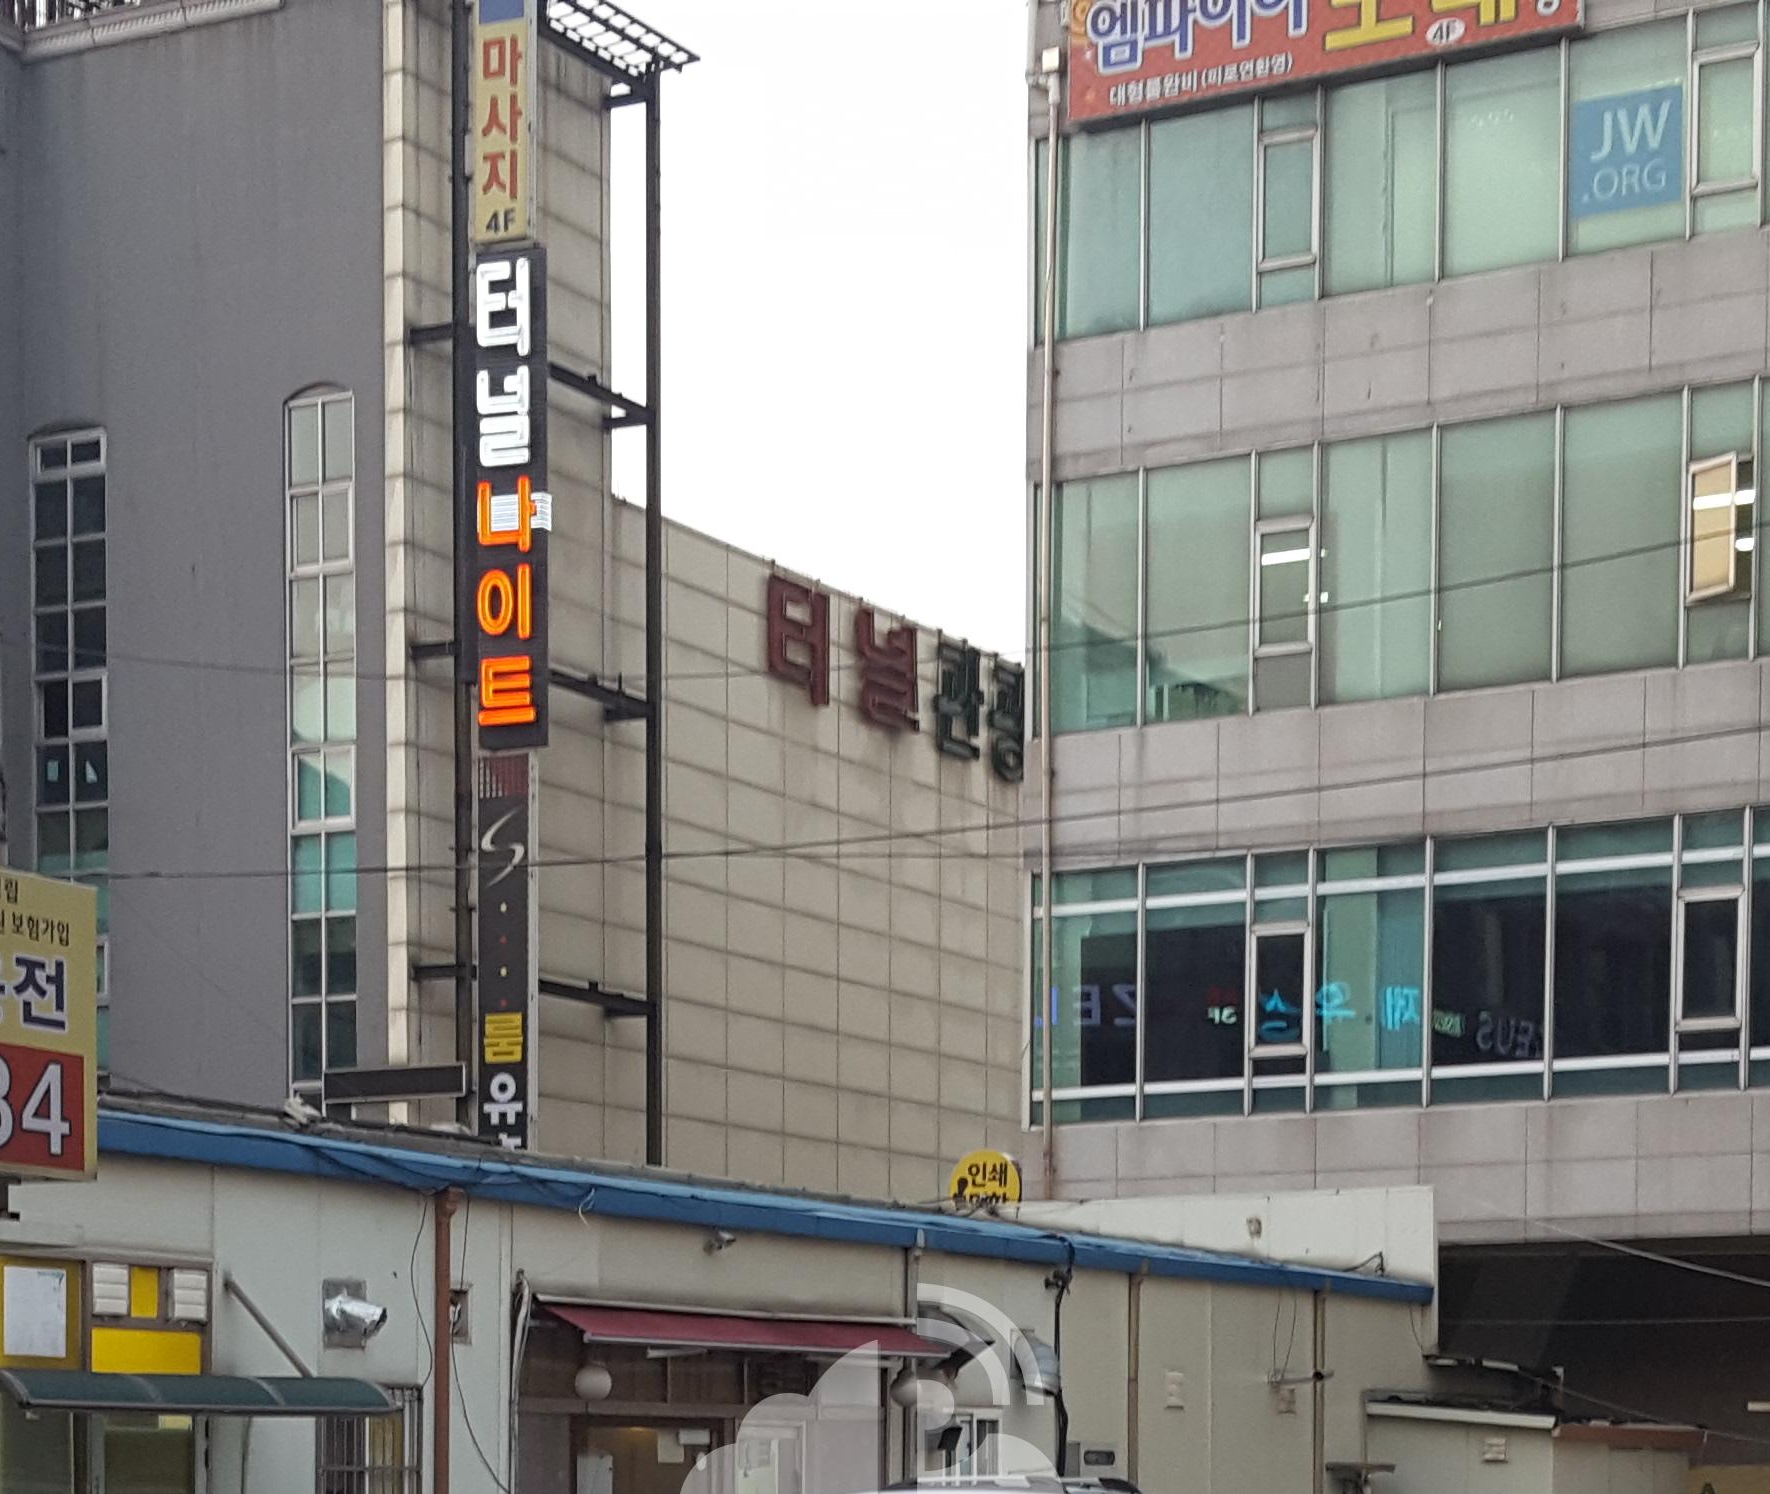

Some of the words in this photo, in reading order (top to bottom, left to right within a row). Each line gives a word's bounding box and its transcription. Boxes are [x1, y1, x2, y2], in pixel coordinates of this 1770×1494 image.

[482, 33, 523, 201] 마사지
[1590, 101, 1672, 162] JW
[485, 208, 517, 235] 4F
[967, 1161, 1008, 1188] 인쇄
